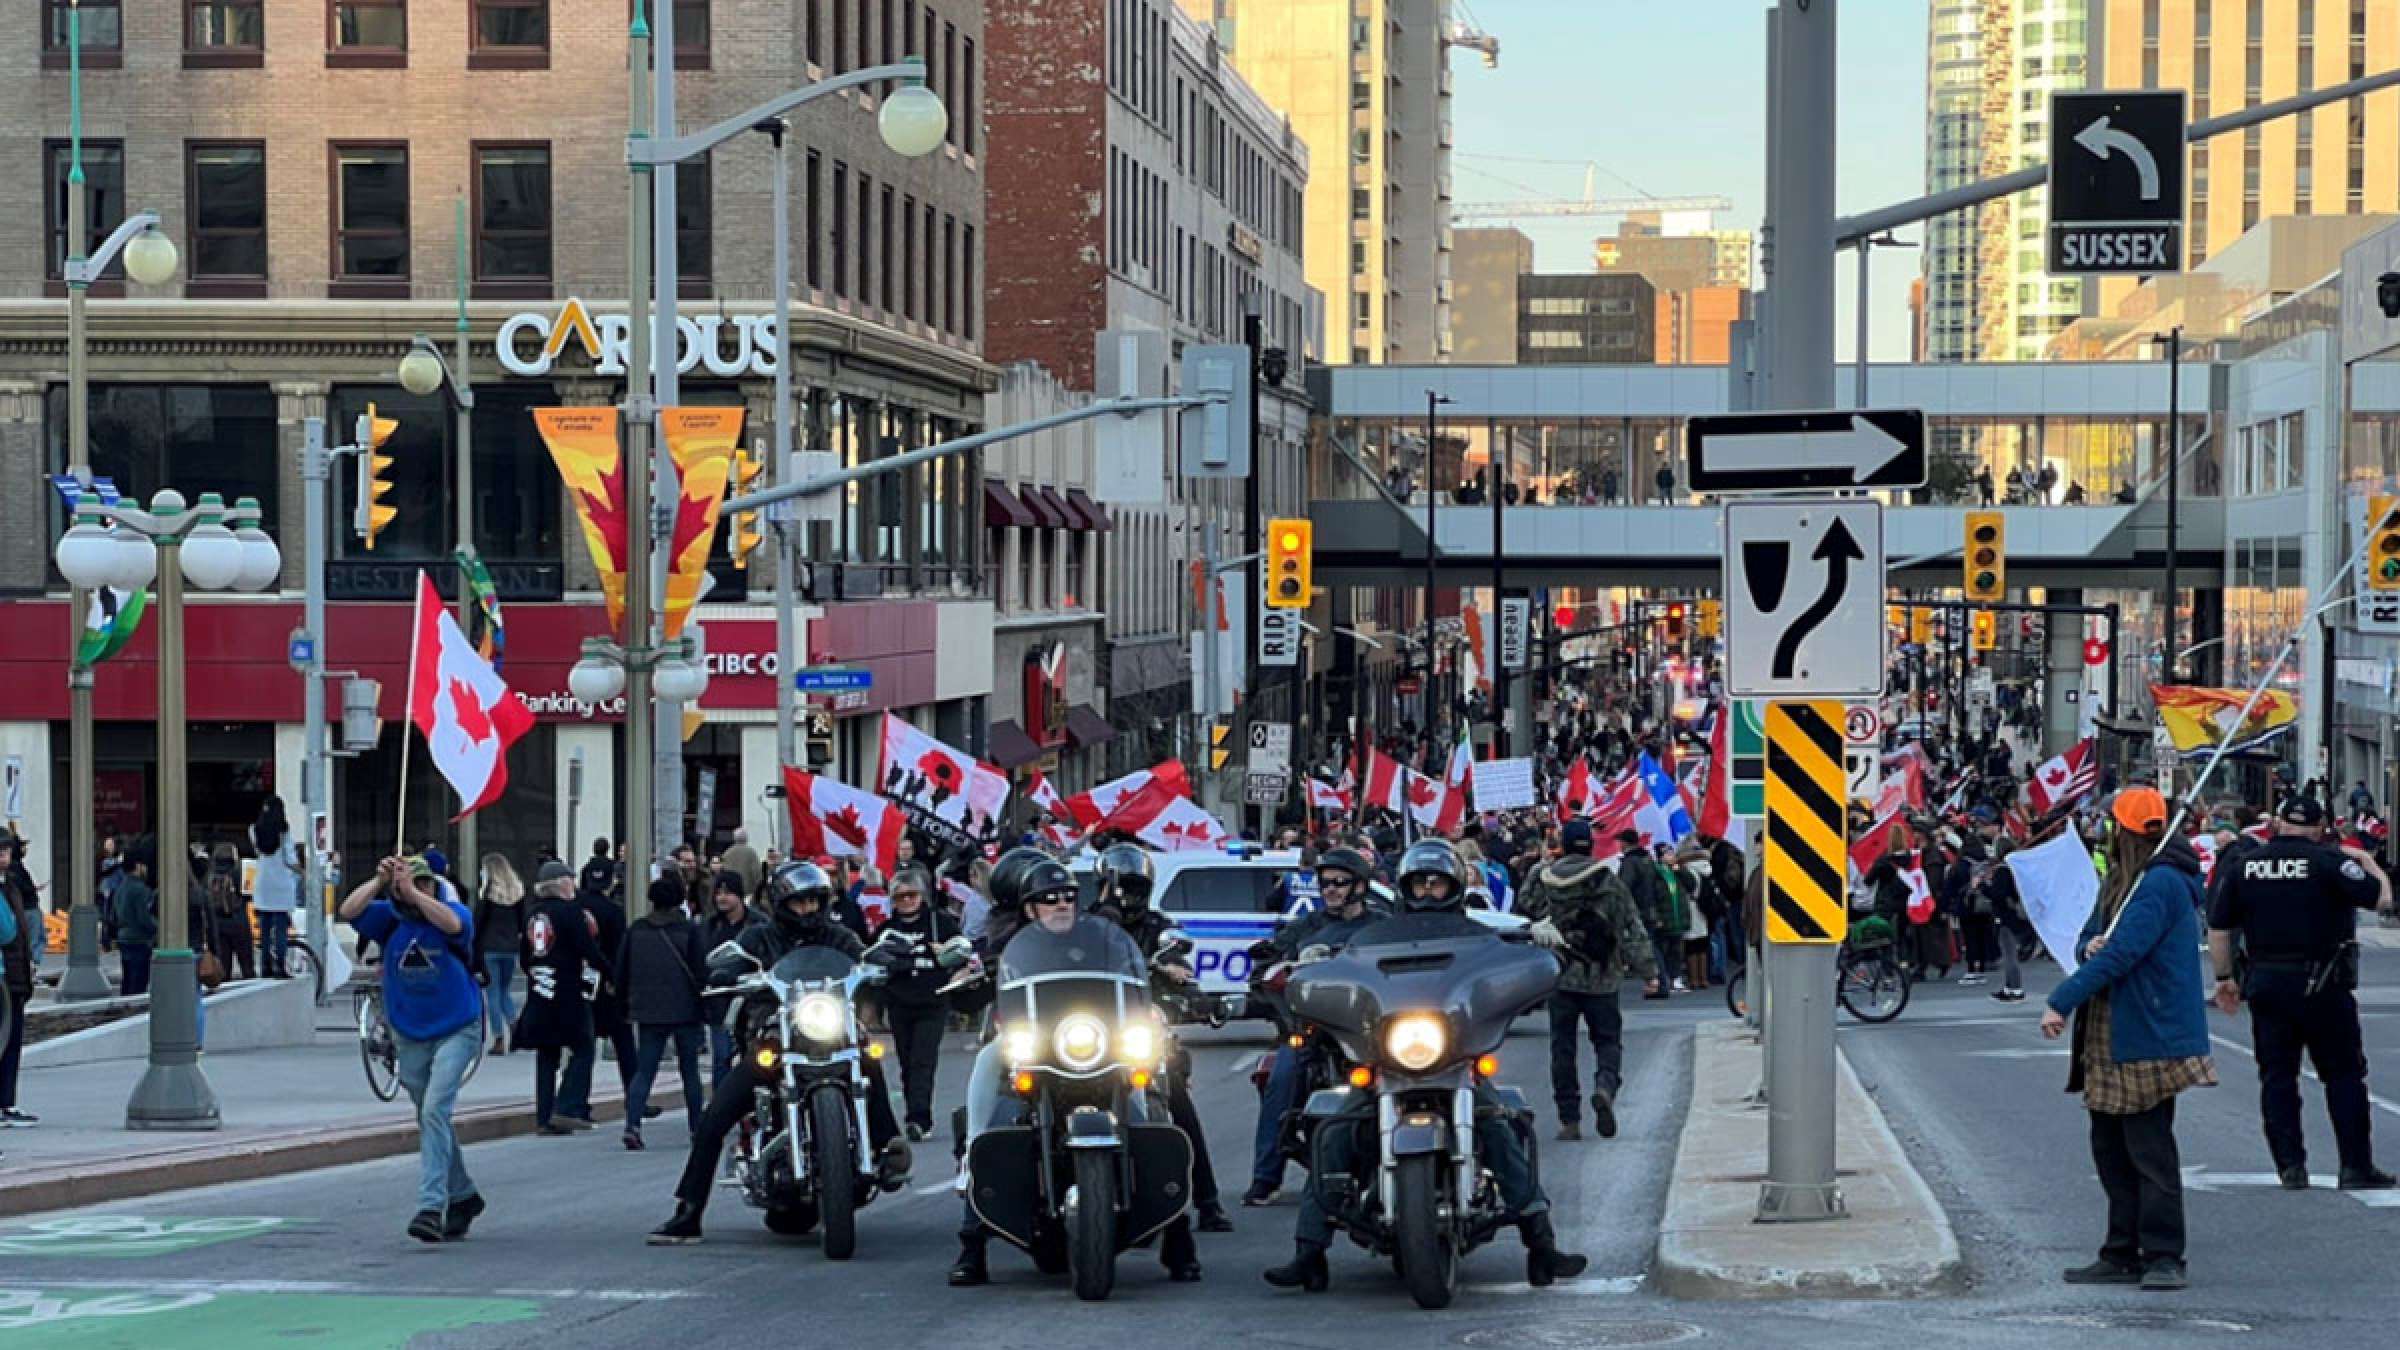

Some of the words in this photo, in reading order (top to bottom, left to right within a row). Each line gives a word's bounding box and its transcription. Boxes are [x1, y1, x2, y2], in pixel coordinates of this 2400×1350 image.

[2063, 233, 2167, 265] SUSSEX
[496, 296, 777, 376] CARDUS
[702, 653, 756, 675] CIBC
[2245, 859, 2309, 880] POLICE
[1194, 949, 1253, 983] PO
